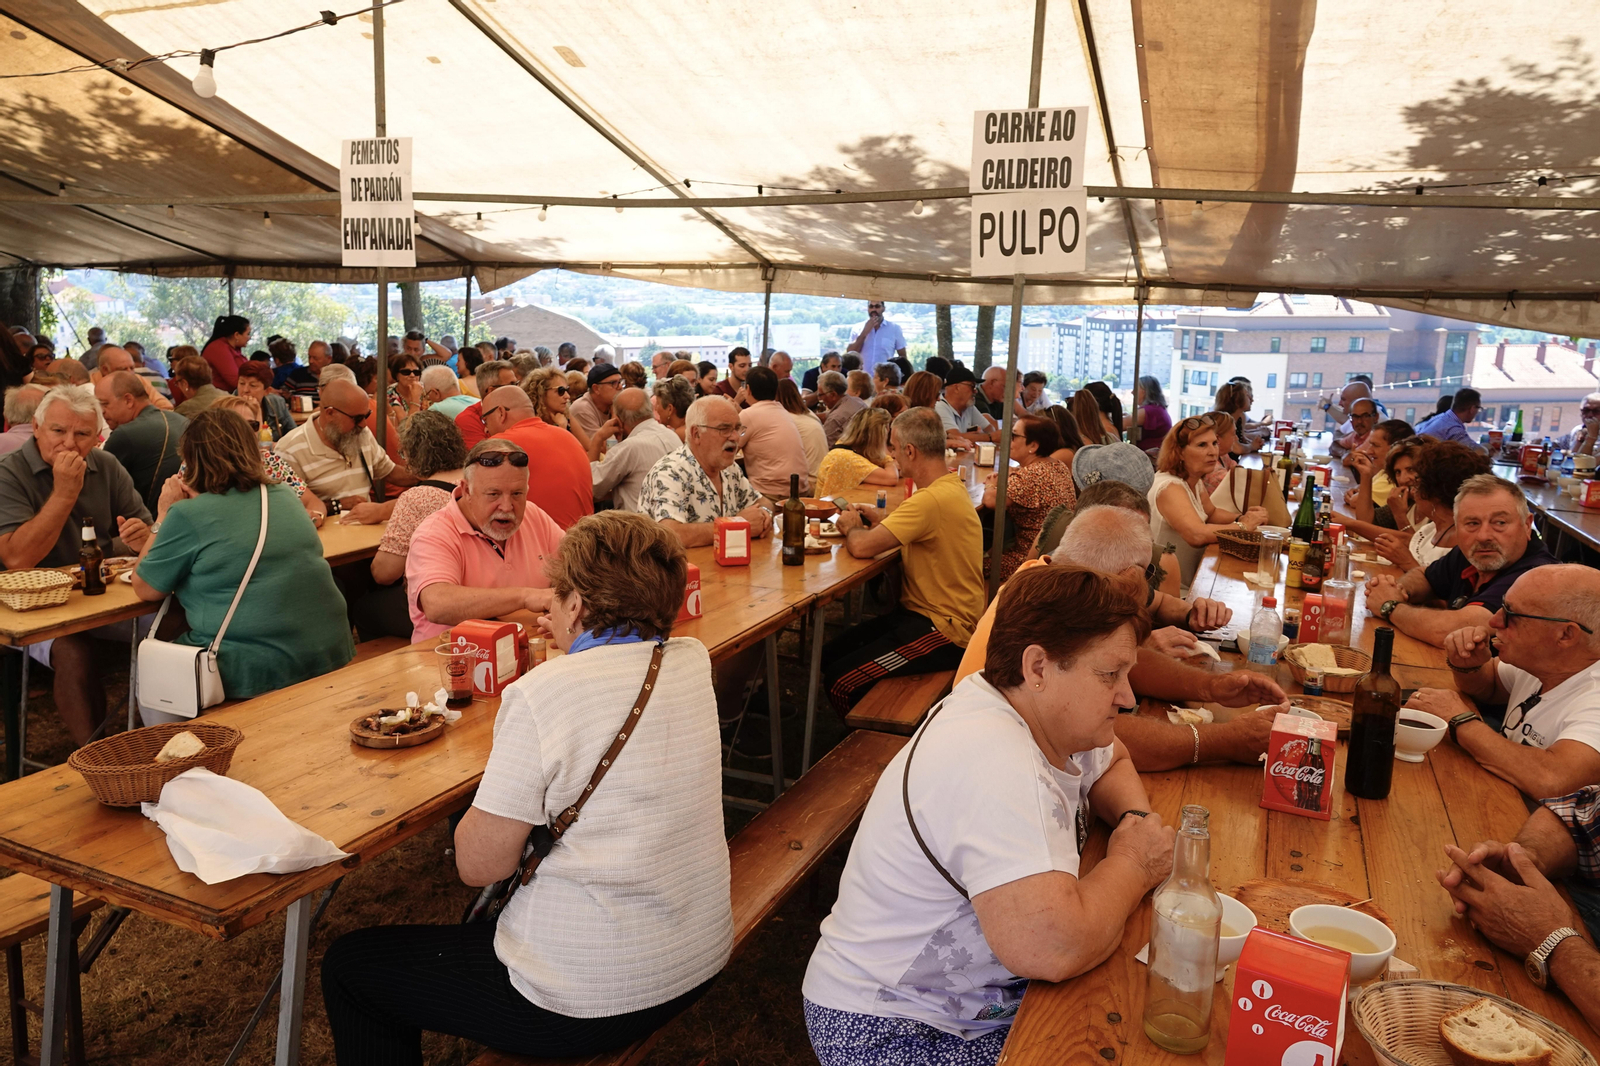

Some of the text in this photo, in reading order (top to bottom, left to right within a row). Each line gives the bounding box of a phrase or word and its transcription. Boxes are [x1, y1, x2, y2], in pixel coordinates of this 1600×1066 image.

[985, 109, 1076, 144] CARNE AO
[350, 139, 400, 165] PEMENTOS
[350, 172, 402, 201] DE PADRÓN
[982, 156, 1072, 190] CALDEIRO
[343, 218, 413, 250] EMPANADA
[979, 206, 1080, 258] PULPO
[464, 647, 490, 660] CCola
[1270, 760, 1326, 784] Coca-Cola
[1264, 1004, 1333, 1038] Coca-Cola
